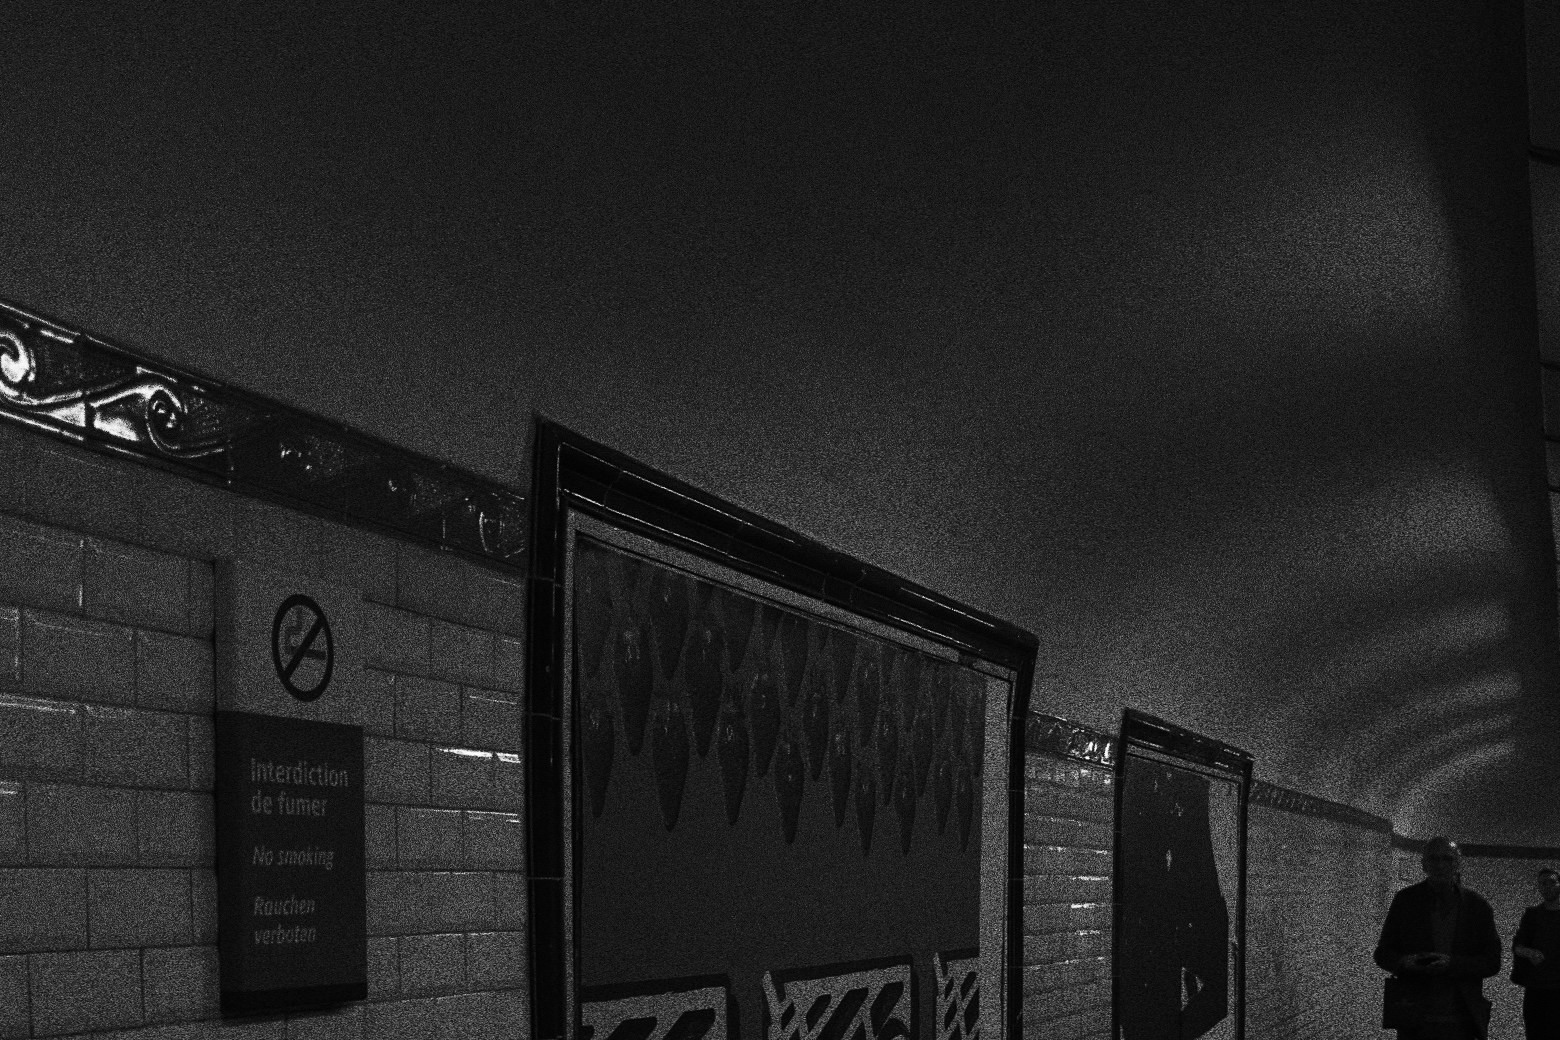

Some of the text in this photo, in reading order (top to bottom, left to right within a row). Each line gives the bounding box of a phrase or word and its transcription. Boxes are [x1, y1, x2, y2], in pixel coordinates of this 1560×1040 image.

[250, 758, 349, 788] Interdiction
[250, 789, 329, 817] de fumer
[252, 845, 334, 871] No smoking
[253, 895, 316, 917] Rauchen
[254, 924, 317, 945] verboten
